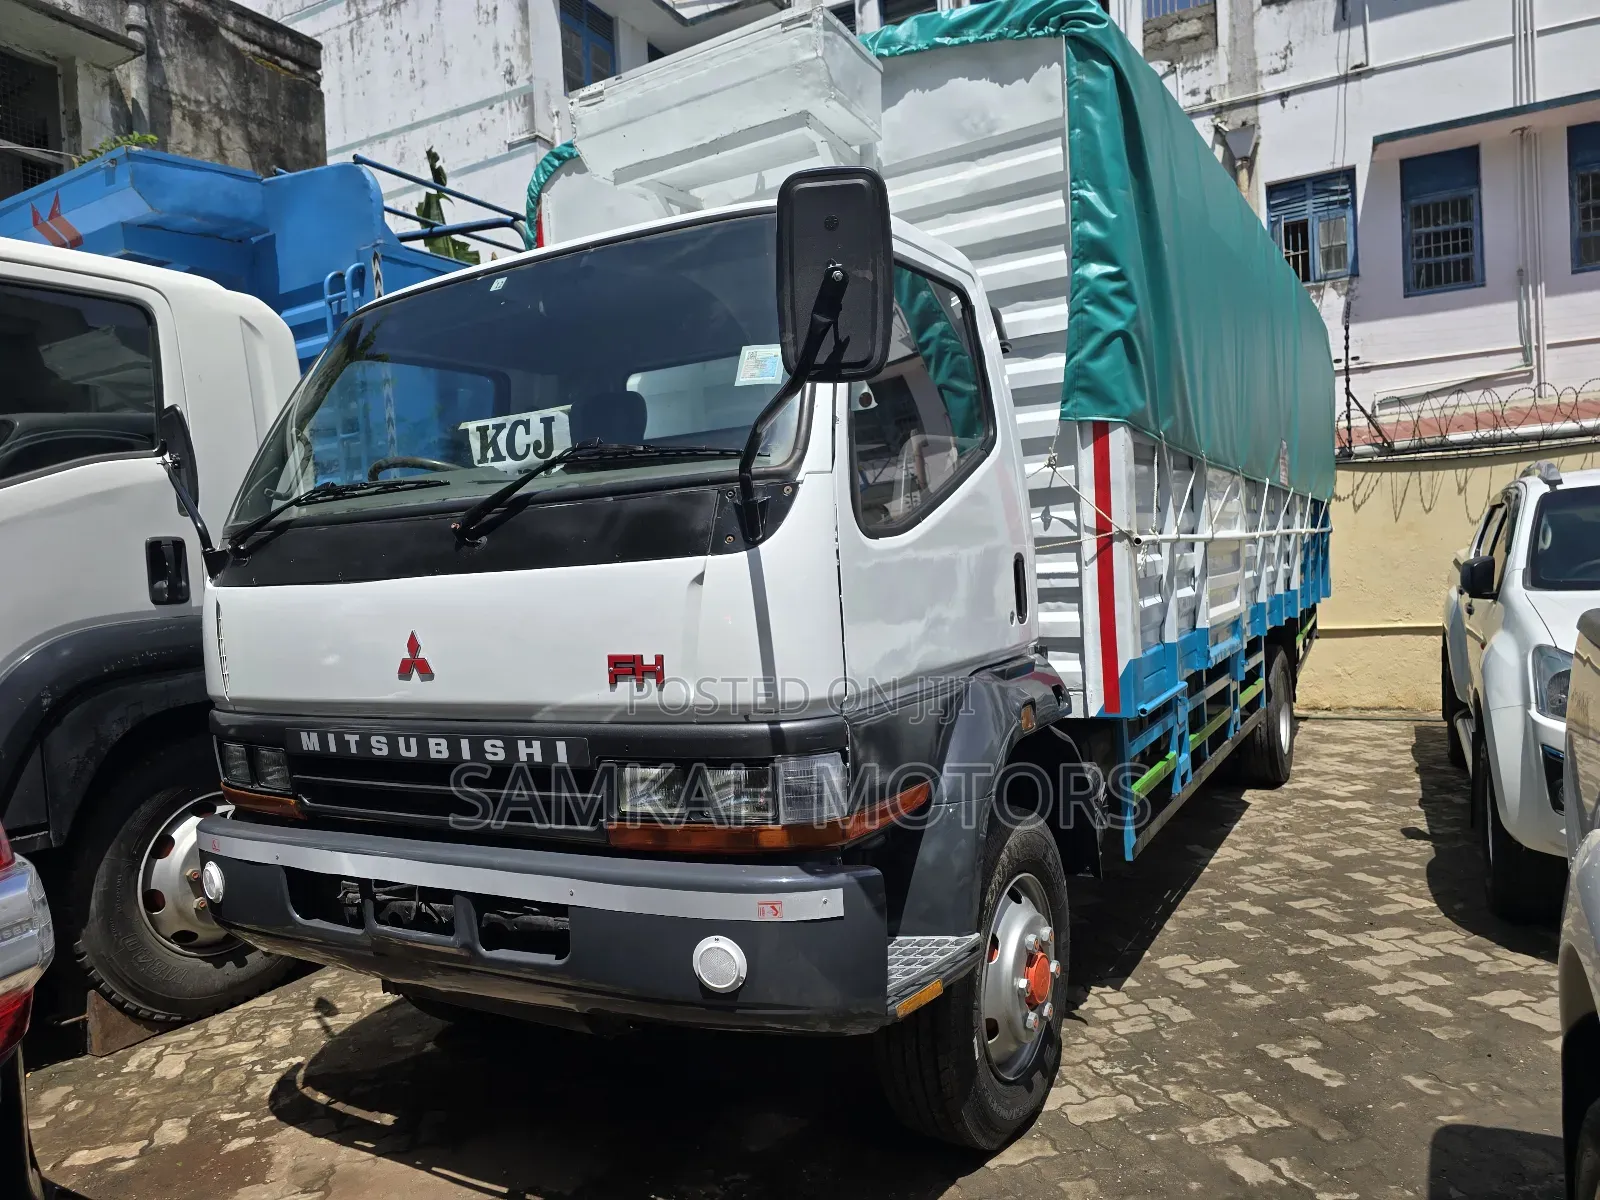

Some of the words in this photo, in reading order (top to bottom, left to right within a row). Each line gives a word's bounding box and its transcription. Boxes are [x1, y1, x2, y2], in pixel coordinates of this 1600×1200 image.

[475, 415, 556, 465] KCJ
[608, 653, 665, 687] FH
[299, 731, 568, 764] MITSUBISHI
